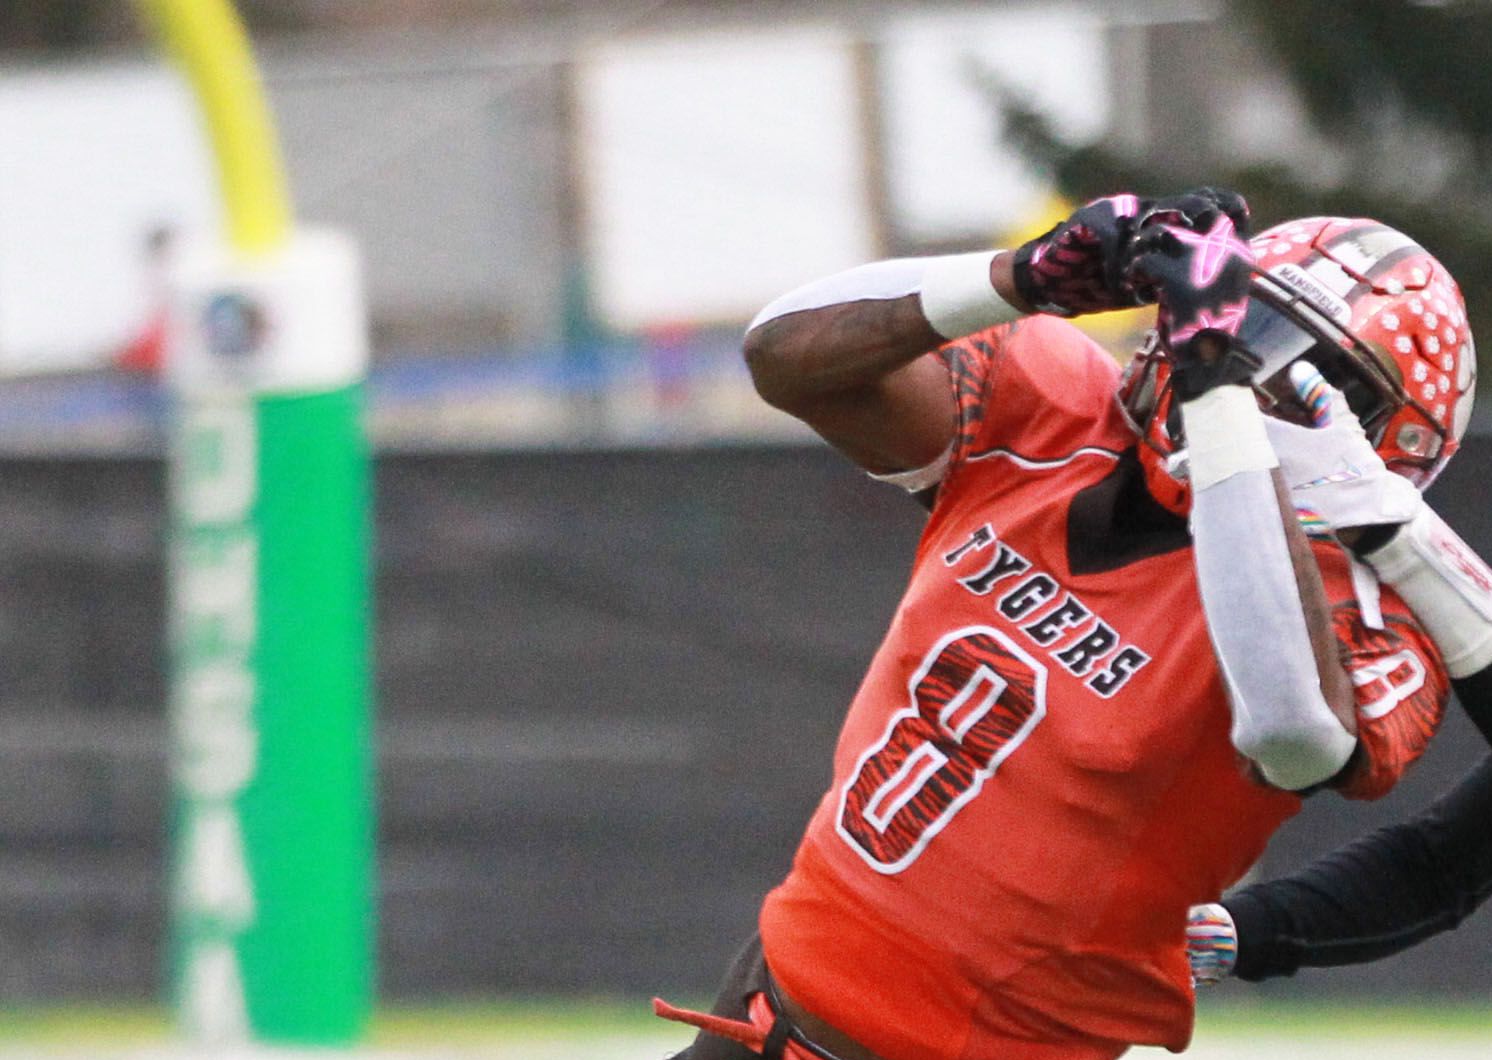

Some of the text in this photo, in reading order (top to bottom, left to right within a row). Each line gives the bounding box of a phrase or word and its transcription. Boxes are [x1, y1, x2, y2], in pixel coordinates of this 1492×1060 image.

[1279, 266, 1343, 318] MANSFIELD
[943, 522, 1153, 700] TYGERS
[834, 625, 1049, 875] 8
